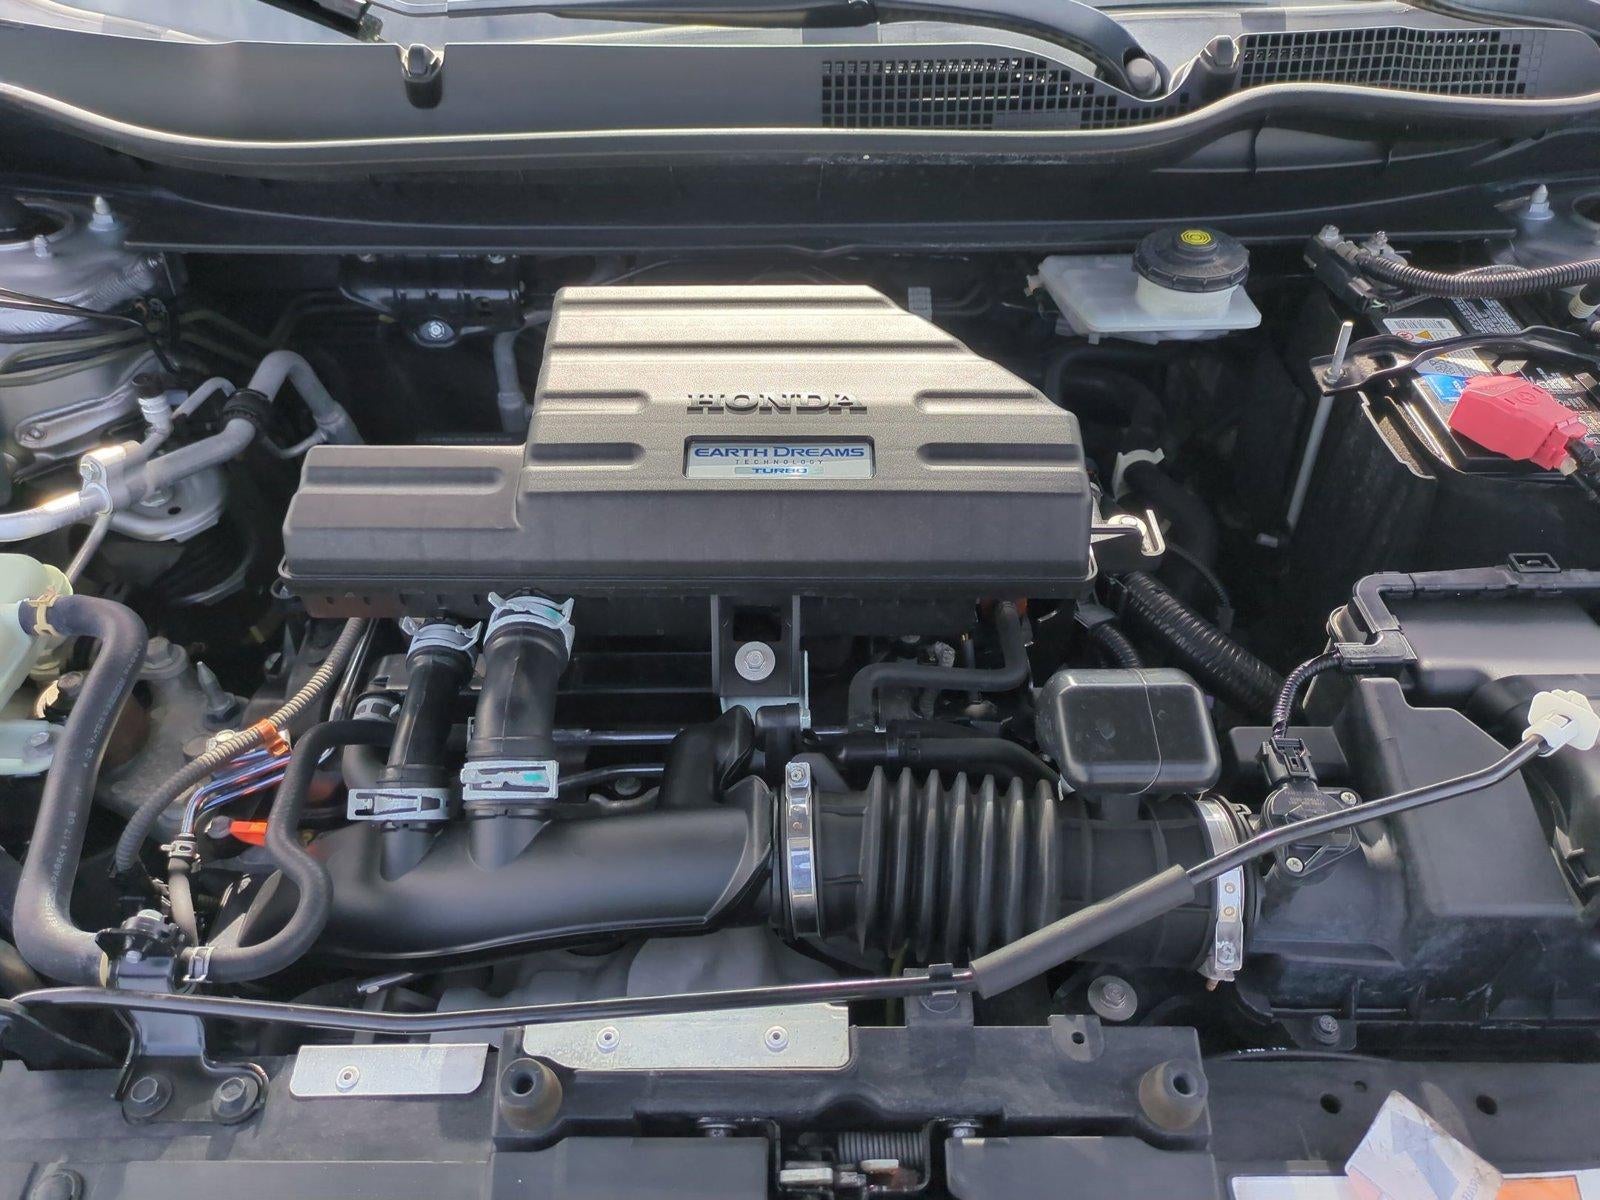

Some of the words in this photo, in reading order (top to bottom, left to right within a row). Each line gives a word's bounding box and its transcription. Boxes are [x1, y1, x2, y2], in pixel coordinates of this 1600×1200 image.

[686, 393, 868, 415] HONDA
[694, 446, 768, 457] EARTH
[773, 445, 865, 458] DREAMS
